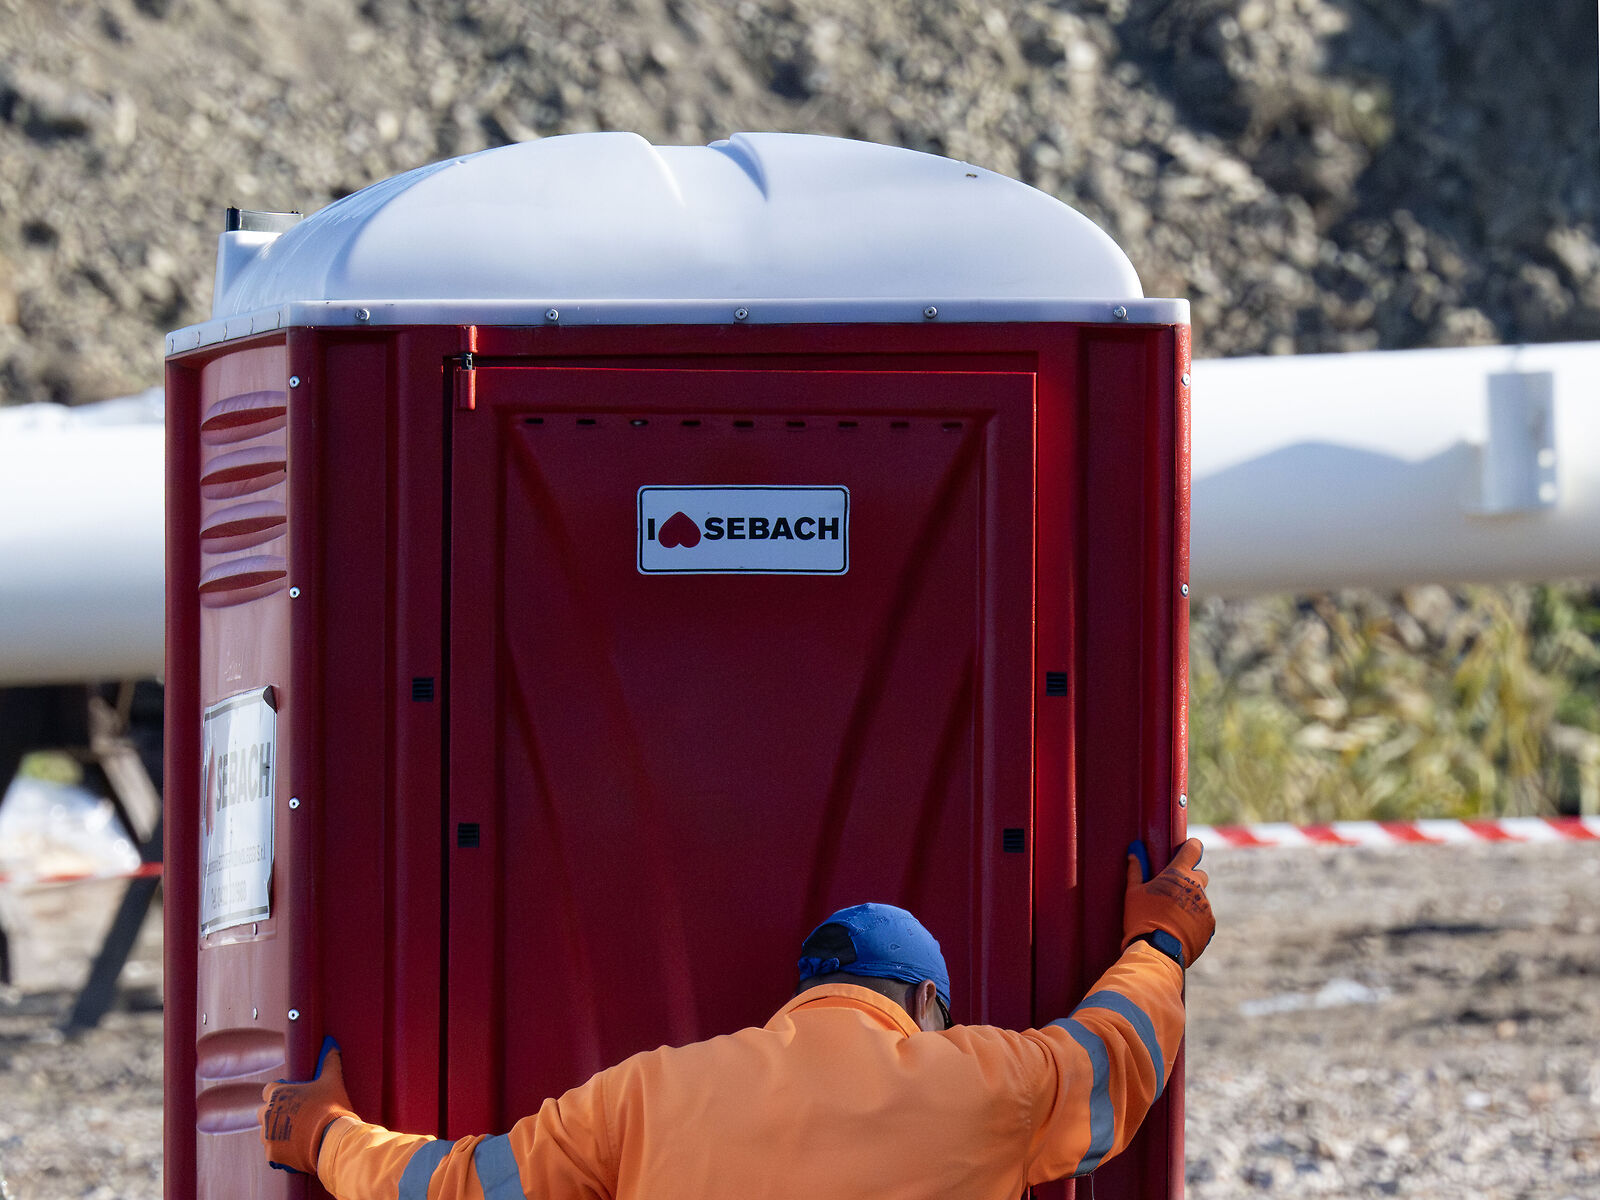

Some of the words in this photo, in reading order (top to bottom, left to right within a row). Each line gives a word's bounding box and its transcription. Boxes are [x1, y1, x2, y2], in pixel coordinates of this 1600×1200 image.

[647, 518, 656, 540] I
[703, 517, 839, 540] SEBACH
[216, 742, 271, 812] SEBACH
